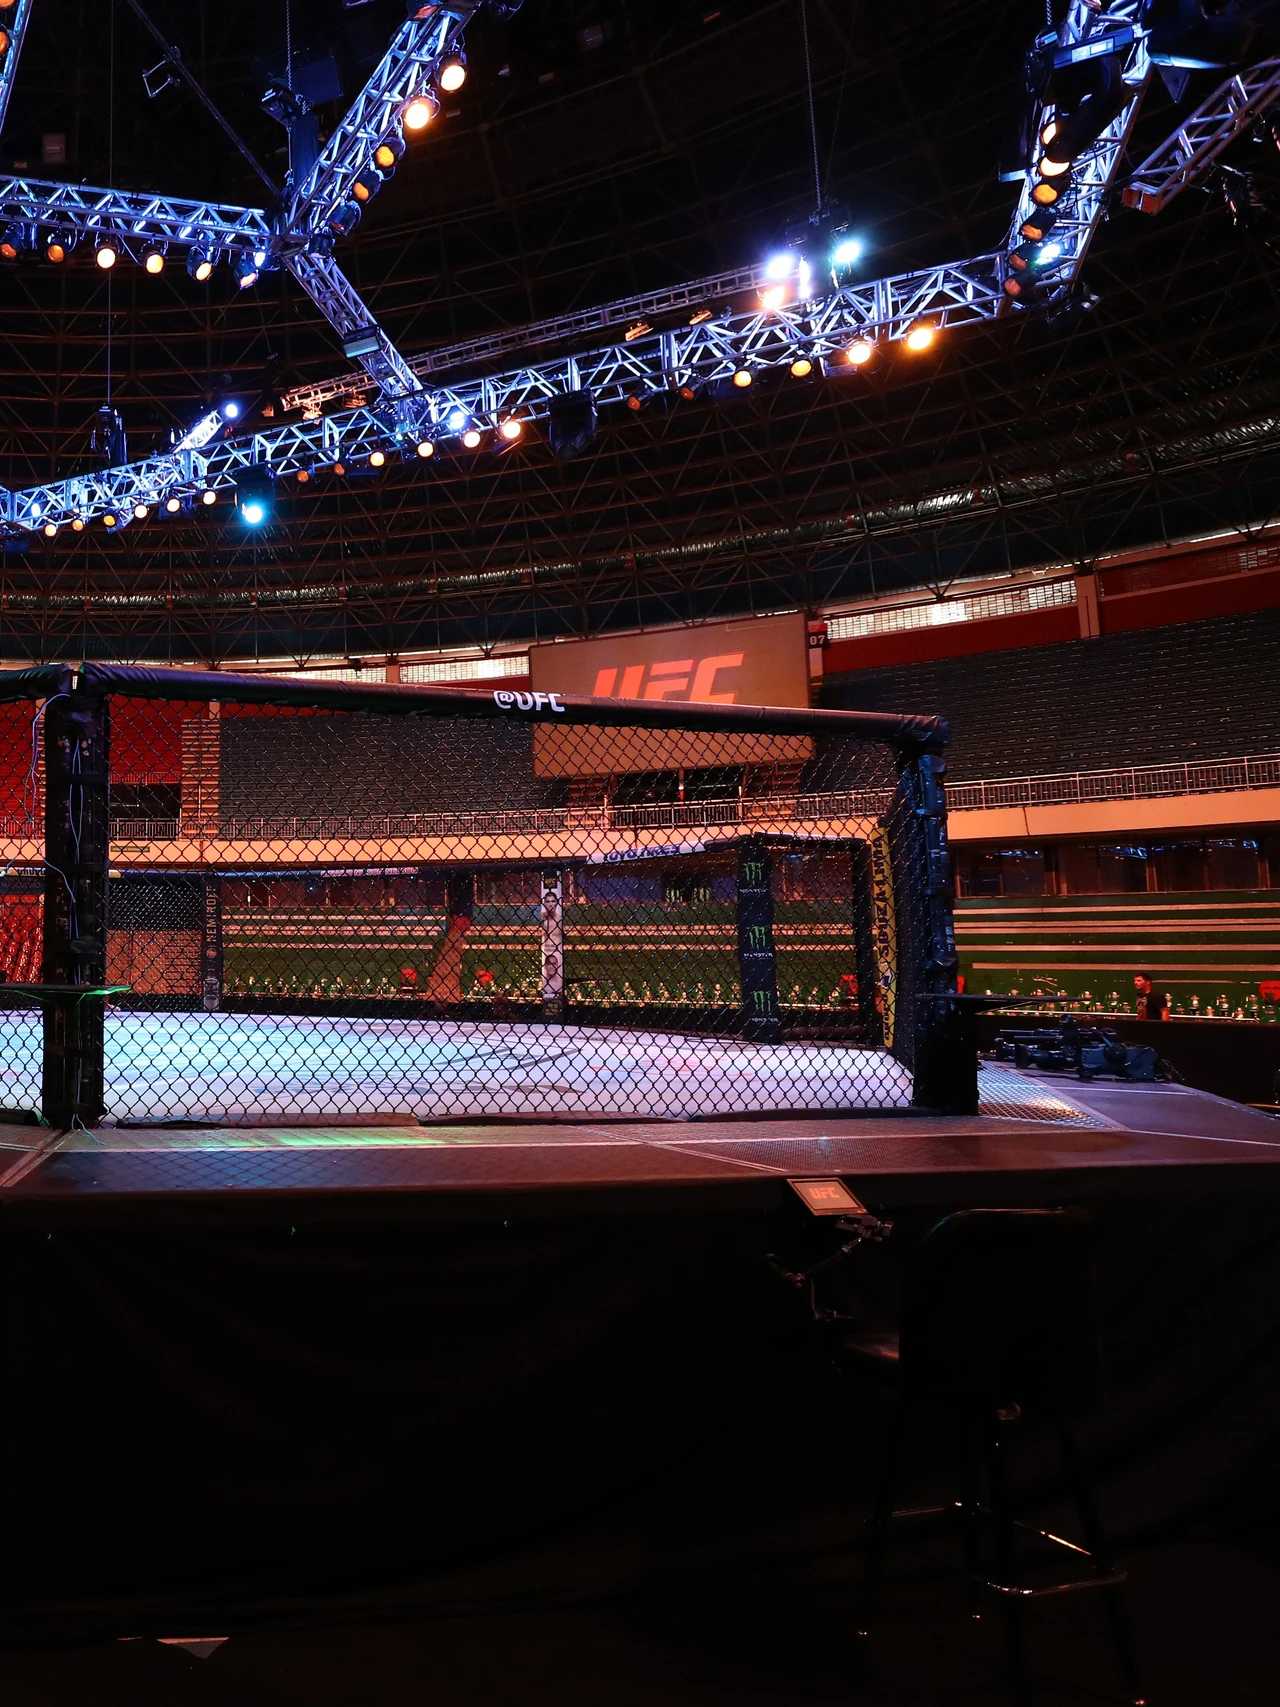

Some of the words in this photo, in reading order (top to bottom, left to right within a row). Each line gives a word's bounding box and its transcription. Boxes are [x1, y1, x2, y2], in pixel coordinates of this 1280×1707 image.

[592, 652, 744, 704] UFC
[493, 690, 566, 712] @UFC
[809, 1187, 840, 1199] UFC
